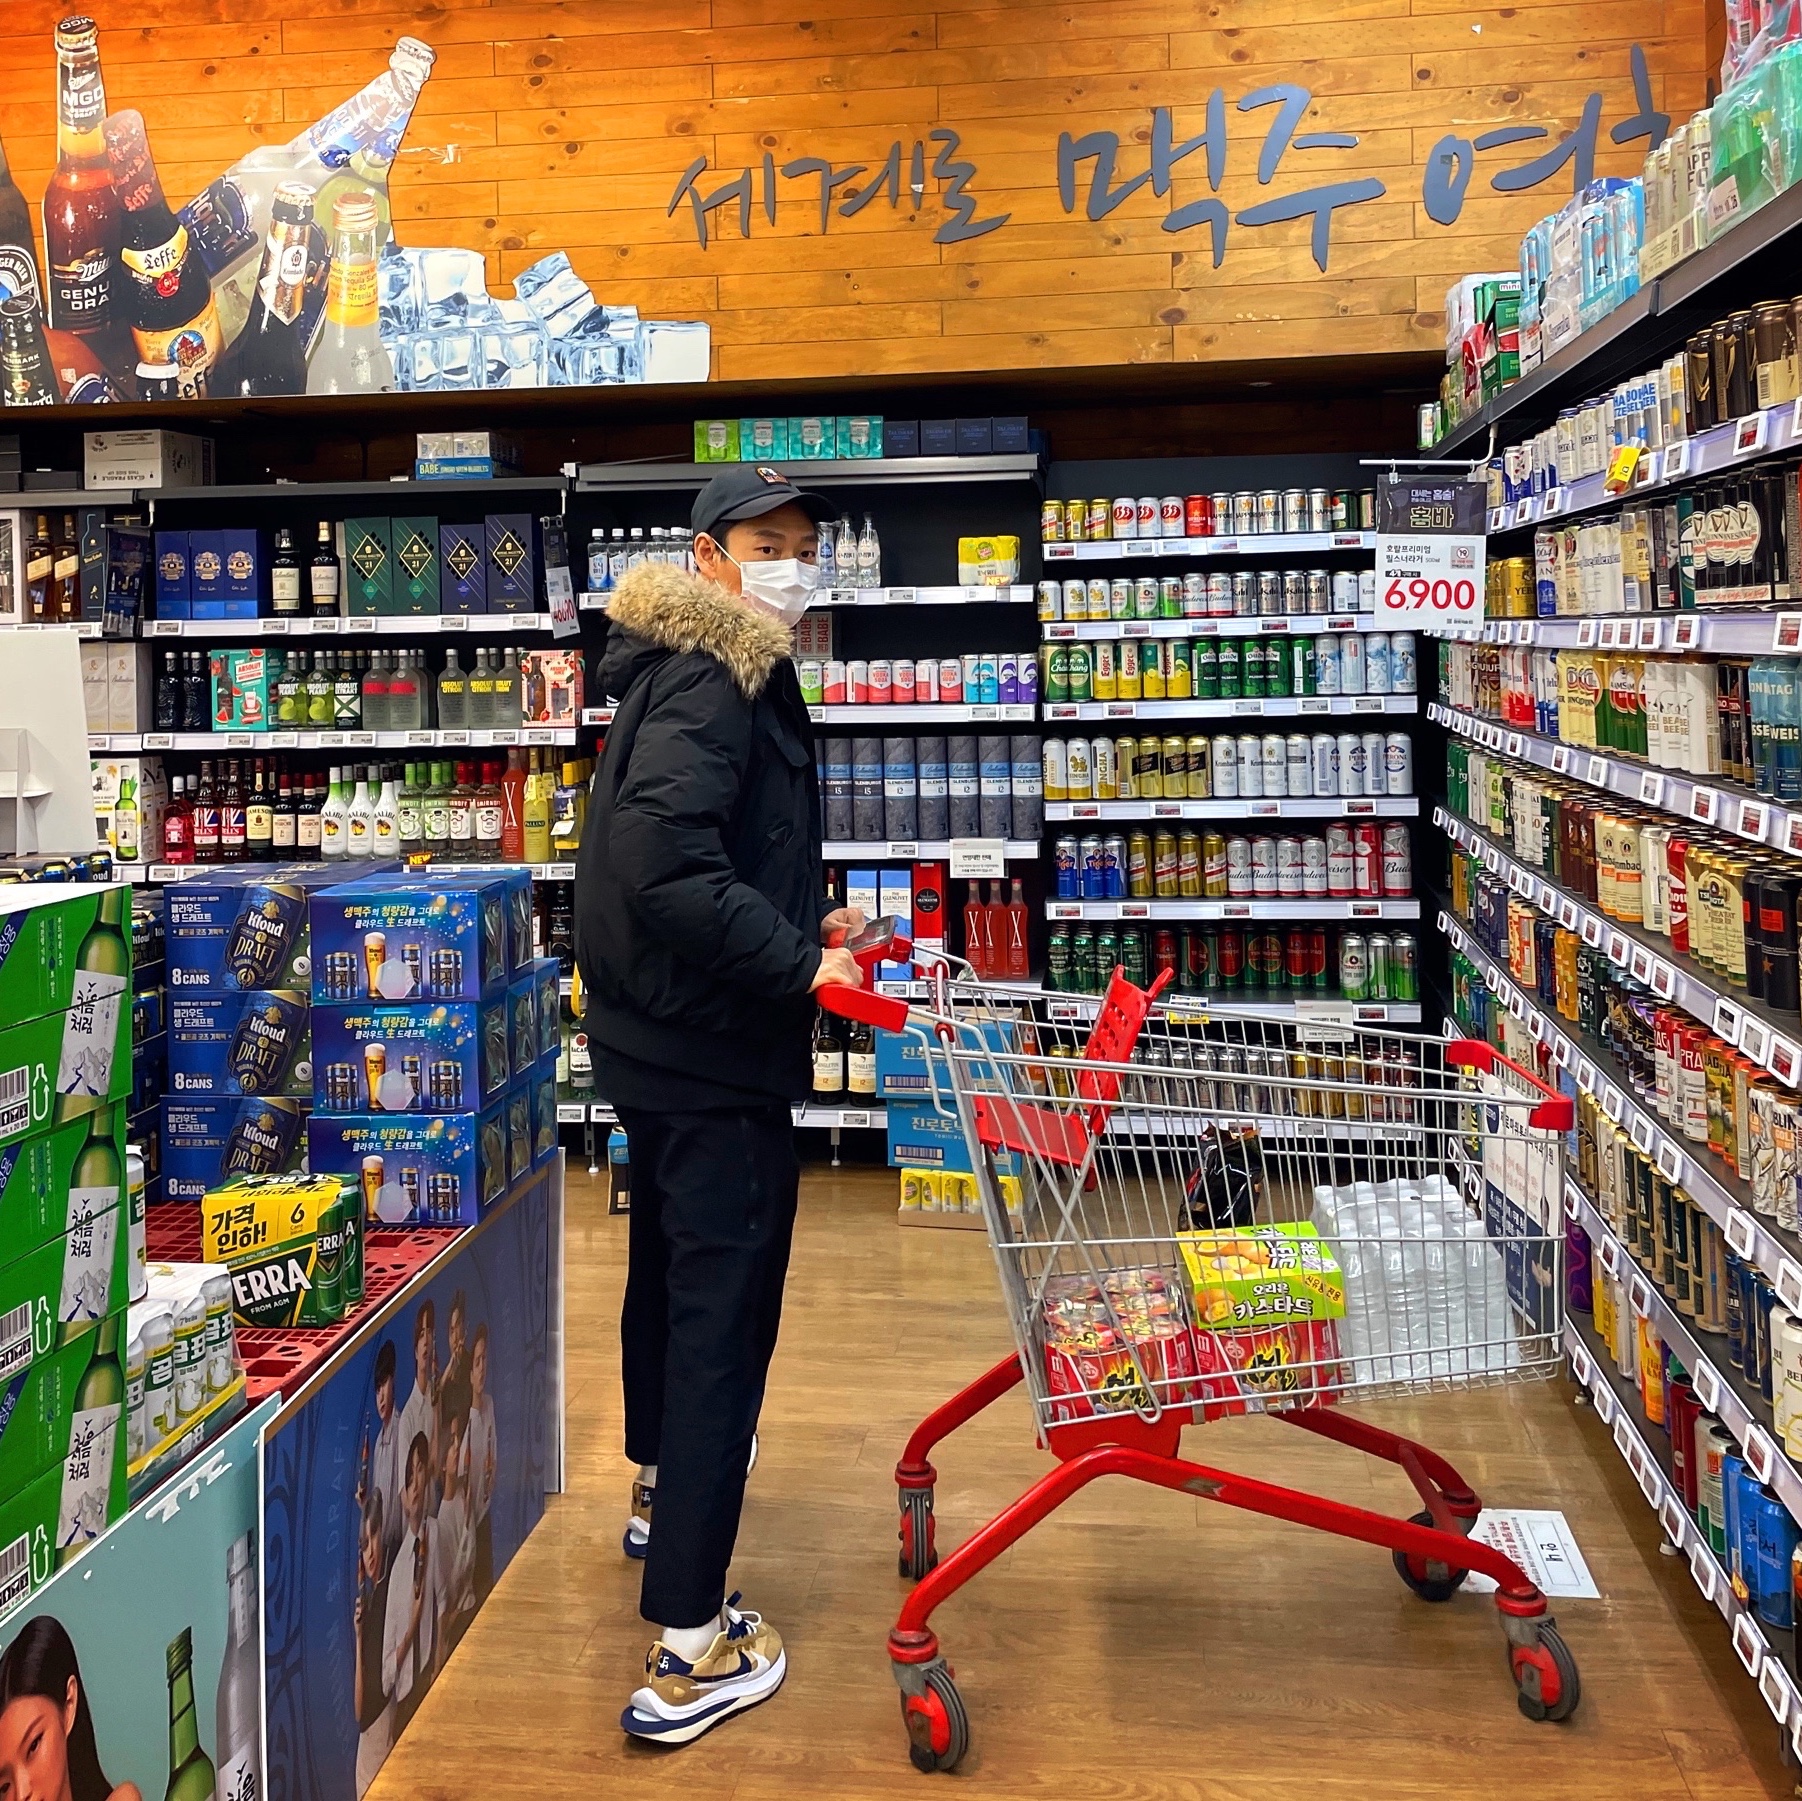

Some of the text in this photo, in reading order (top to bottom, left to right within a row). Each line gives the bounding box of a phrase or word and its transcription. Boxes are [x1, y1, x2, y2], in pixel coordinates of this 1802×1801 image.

[62, 85, 104, 106] MGD
[668, 129, 1012, 250] 세계로
[1057, 84, 1386, 272] 맥주
[144, 246, 179, 270] Leffe
[1500, 282, 1520, 292] mini
[419, 464, 440, 475] BABE
[1410, 506, 1455, 528] 홈바
[364, 560, 374, 570] 21
[411, 560, 421, 569] 21
[504, 557, 514, 566] 21
[1386, 555, 1424, 563] 필스너라거
[458, 562, 467, 571] 21
[1389, 569, 1402, 578] 4개
[985, 575, 1009, 586] NEW
[1385, 579, 1476, 611] 6,900
[800, 616, 812, 644] BABE
[817, 616, 829, 644] BABE
[835, 787, 842, 795] 15
[864, 787, 872, 795] 15
[998, 785, 1005, 793] 12
[1028, 785, 1035, 793] 12
[408, 853, 432, 865] NEW
[1056, 860, 1074, 869] Tiger
[170, 903, 202, 914] 클라우드
[343, 904, 440, 918] 생맥주의 청량감을 그대로
[170, 913, 212, 924] 생 드래프트
[248, 911, 284, 937] Kloud
[355, 917, 426, 929] 클라우드 生 드래프트
[233, 936, 277, 969] DRAFT
[172, 968, 210, 986] 8 CANS
[173, 1009, 204, 1018] 클라우드
[70, 1013, 93, 1035] 처럼
[173, 1018, 214, 1028] 생 드래프트
[250, 1016, 286, 1043] Kloud
[343, 1016, 440, 1029] 생맥주의 청량감을 그대로
[355, 1028, 426, 1040] 클라우드 生 드래프트
[235, 1040, 279, 1074] DRAFT
[174, 1073, 213, 1090] 8 CANS
[167, 1114, 198, 1124] 클라우드
[167, 1123, 208, 1134] 생 드래프트
[341, 1127, 437, 1141] 생맥주의 청량감을 그대로
[242, 1123, 279, 1151] Kloud
[352, 1140, 423, 1152] 클라우드 生 드래프트
[229, 1147, 272, 1176] DRAFT
[167, 1179, 206, 1196] 8 CANS
[210, 1202, 256, 1235] 가격
[290, 1202, 305, 1224] 6
[217, 1220, 267, 1255] 인하!
[317, 1232, 344, 1252] ERRA
[70, 1239, 92, 1259] 처럼
[231, 1258, 313, 1308] ERRA
[1252, 1282, 1290, 1296] 오리온
[250, 1297, 290, 1315] FROM AGM
[1233, 1296, 1314, 1321] 카스타드
[68, 1461, 90, 1482] 처럼
[1539, 1542, 1564, 1563] 안내
